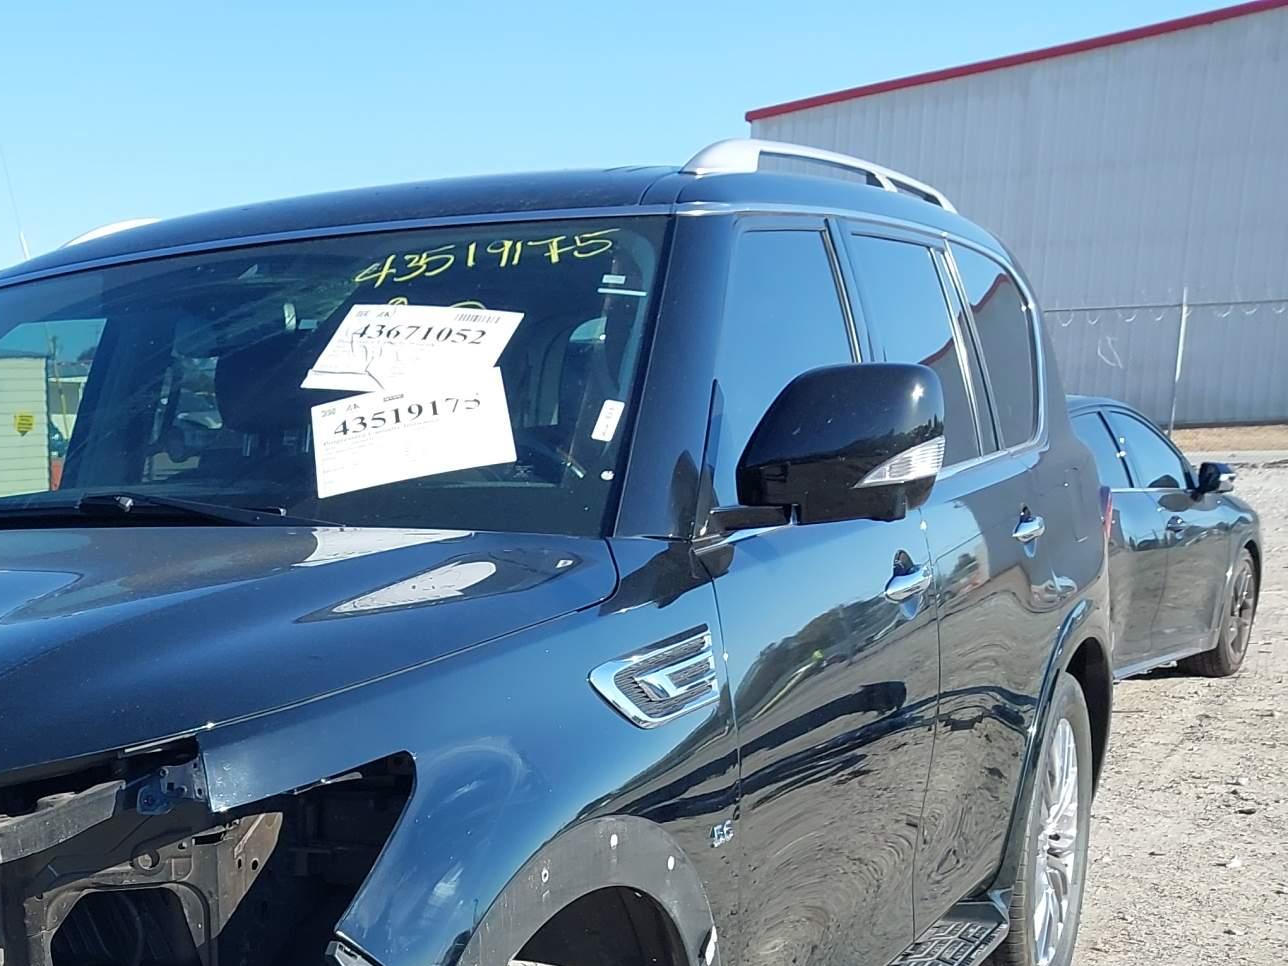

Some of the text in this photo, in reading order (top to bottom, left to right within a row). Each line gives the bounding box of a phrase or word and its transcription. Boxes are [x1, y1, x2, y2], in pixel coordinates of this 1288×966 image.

[354, 228, 621, 288] 43519175
[351, 323, 487, 345] 43671052
[333, 392, 481, 436] 43519175
